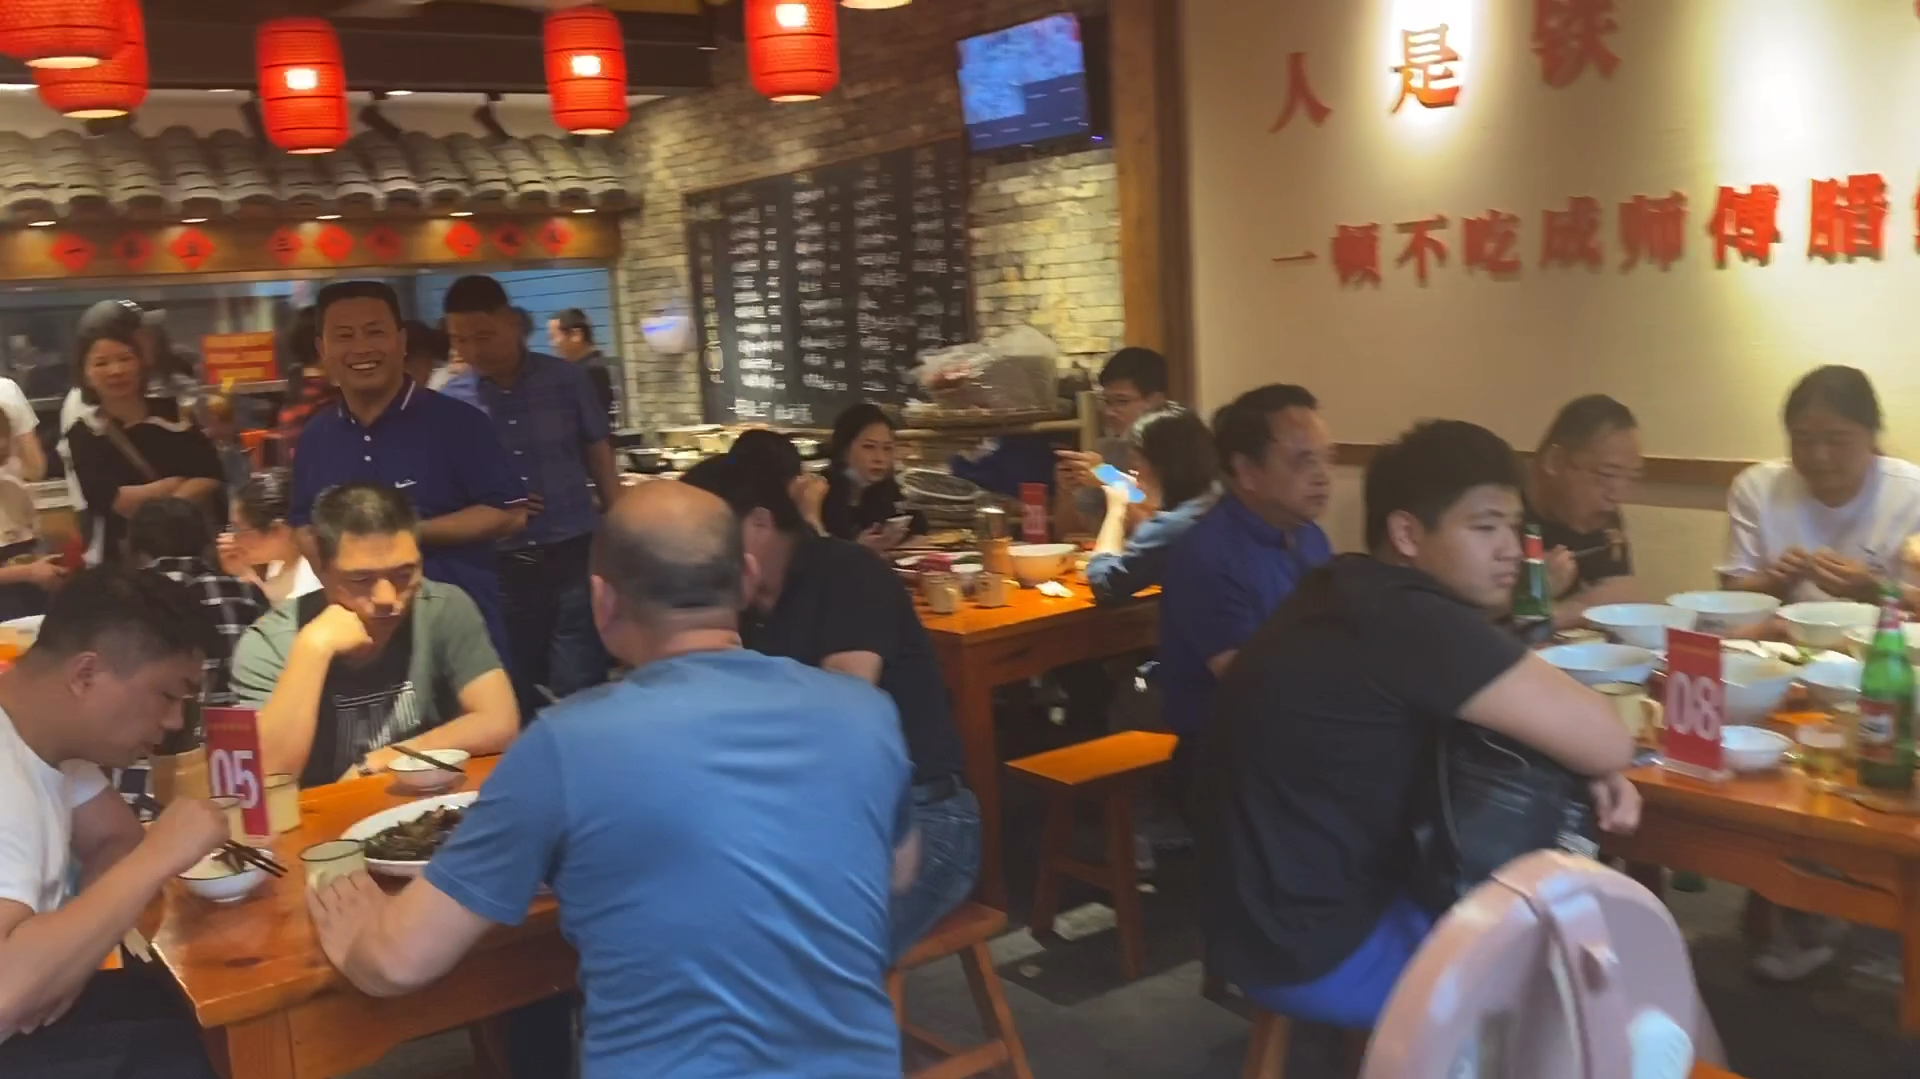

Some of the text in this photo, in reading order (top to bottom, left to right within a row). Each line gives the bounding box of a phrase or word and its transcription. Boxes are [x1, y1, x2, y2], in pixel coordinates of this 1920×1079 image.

[1271, 173, 1920, 289] 一顿不吃成师傅腊
[1667, 670, 1723, 741] 08
[209, 748, 259, 809] 05
